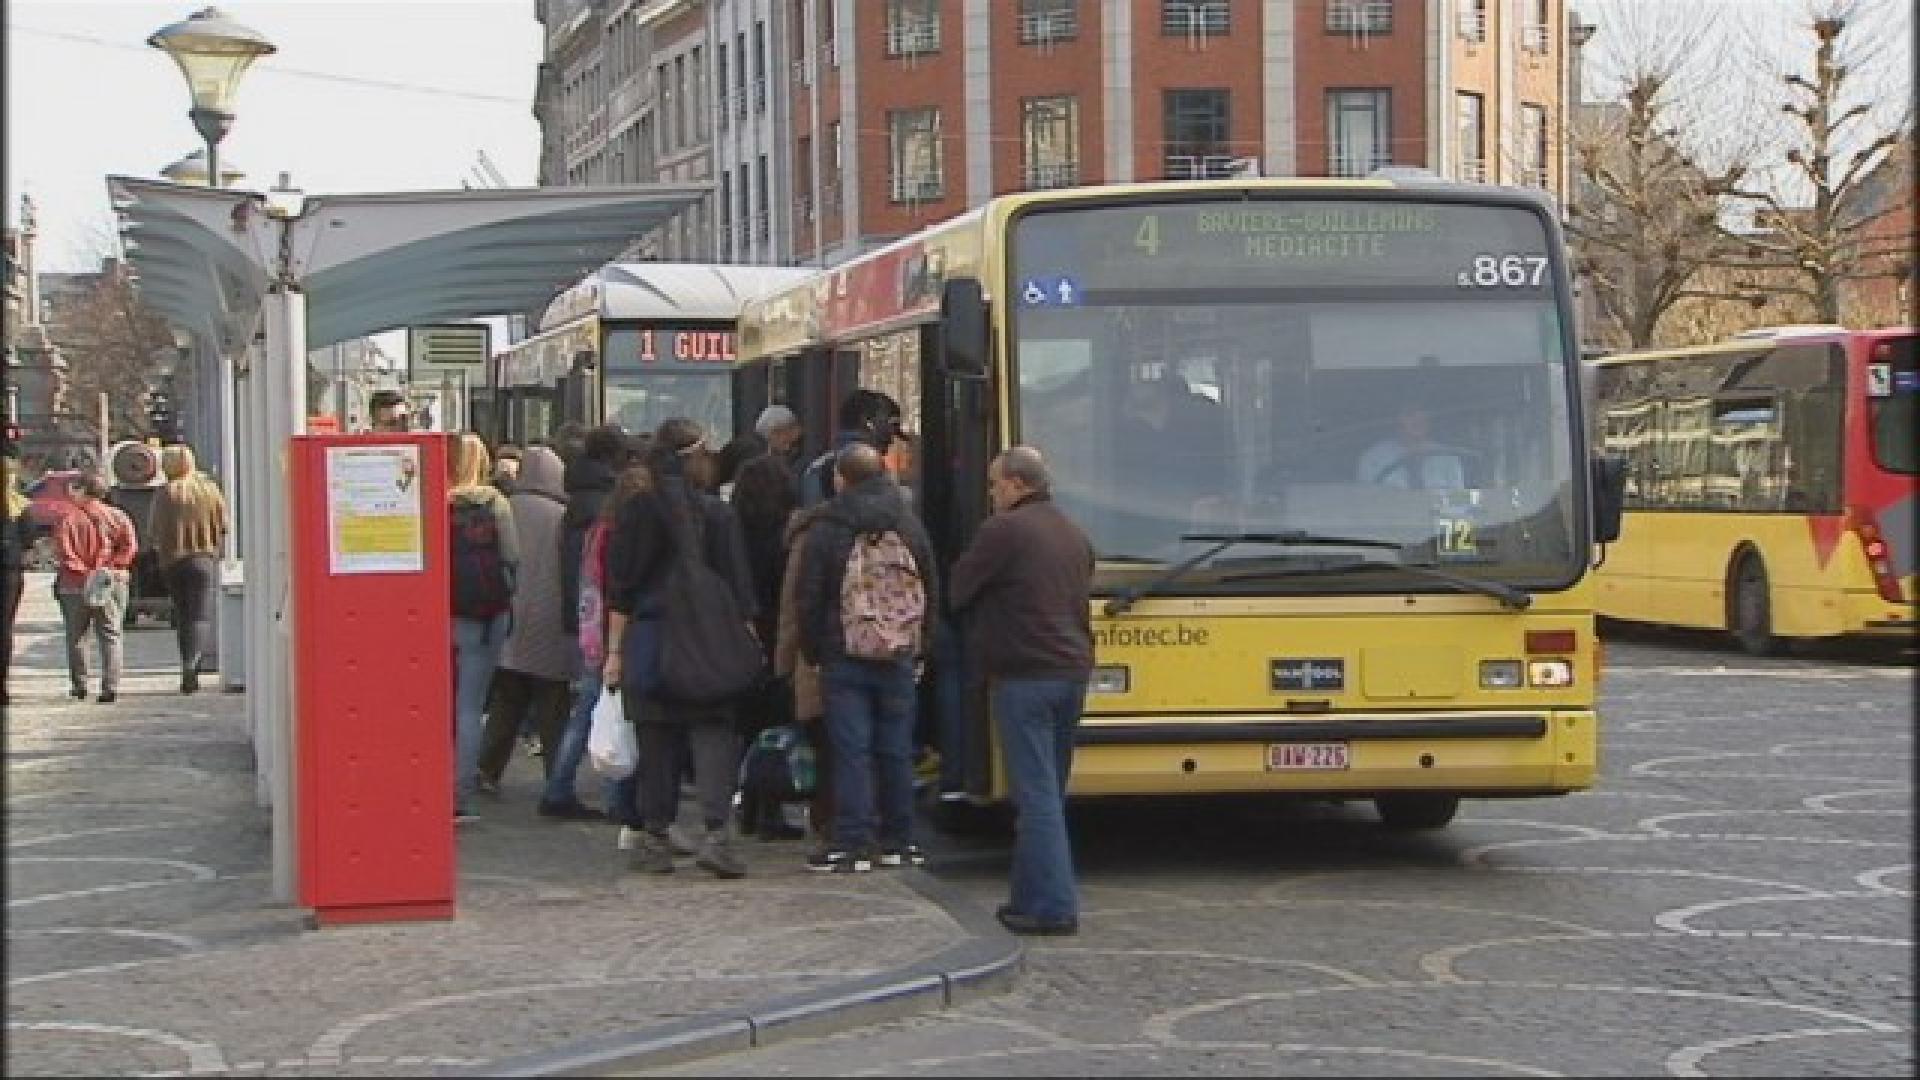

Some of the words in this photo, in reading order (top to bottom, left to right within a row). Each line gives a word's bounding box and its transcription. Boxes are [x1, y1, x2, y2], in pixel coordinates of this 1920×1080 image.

[1135, 215, 1159, 256] 4
[641, 329, 655, 361] 1
[1440, 518, 1474, 551] 72
